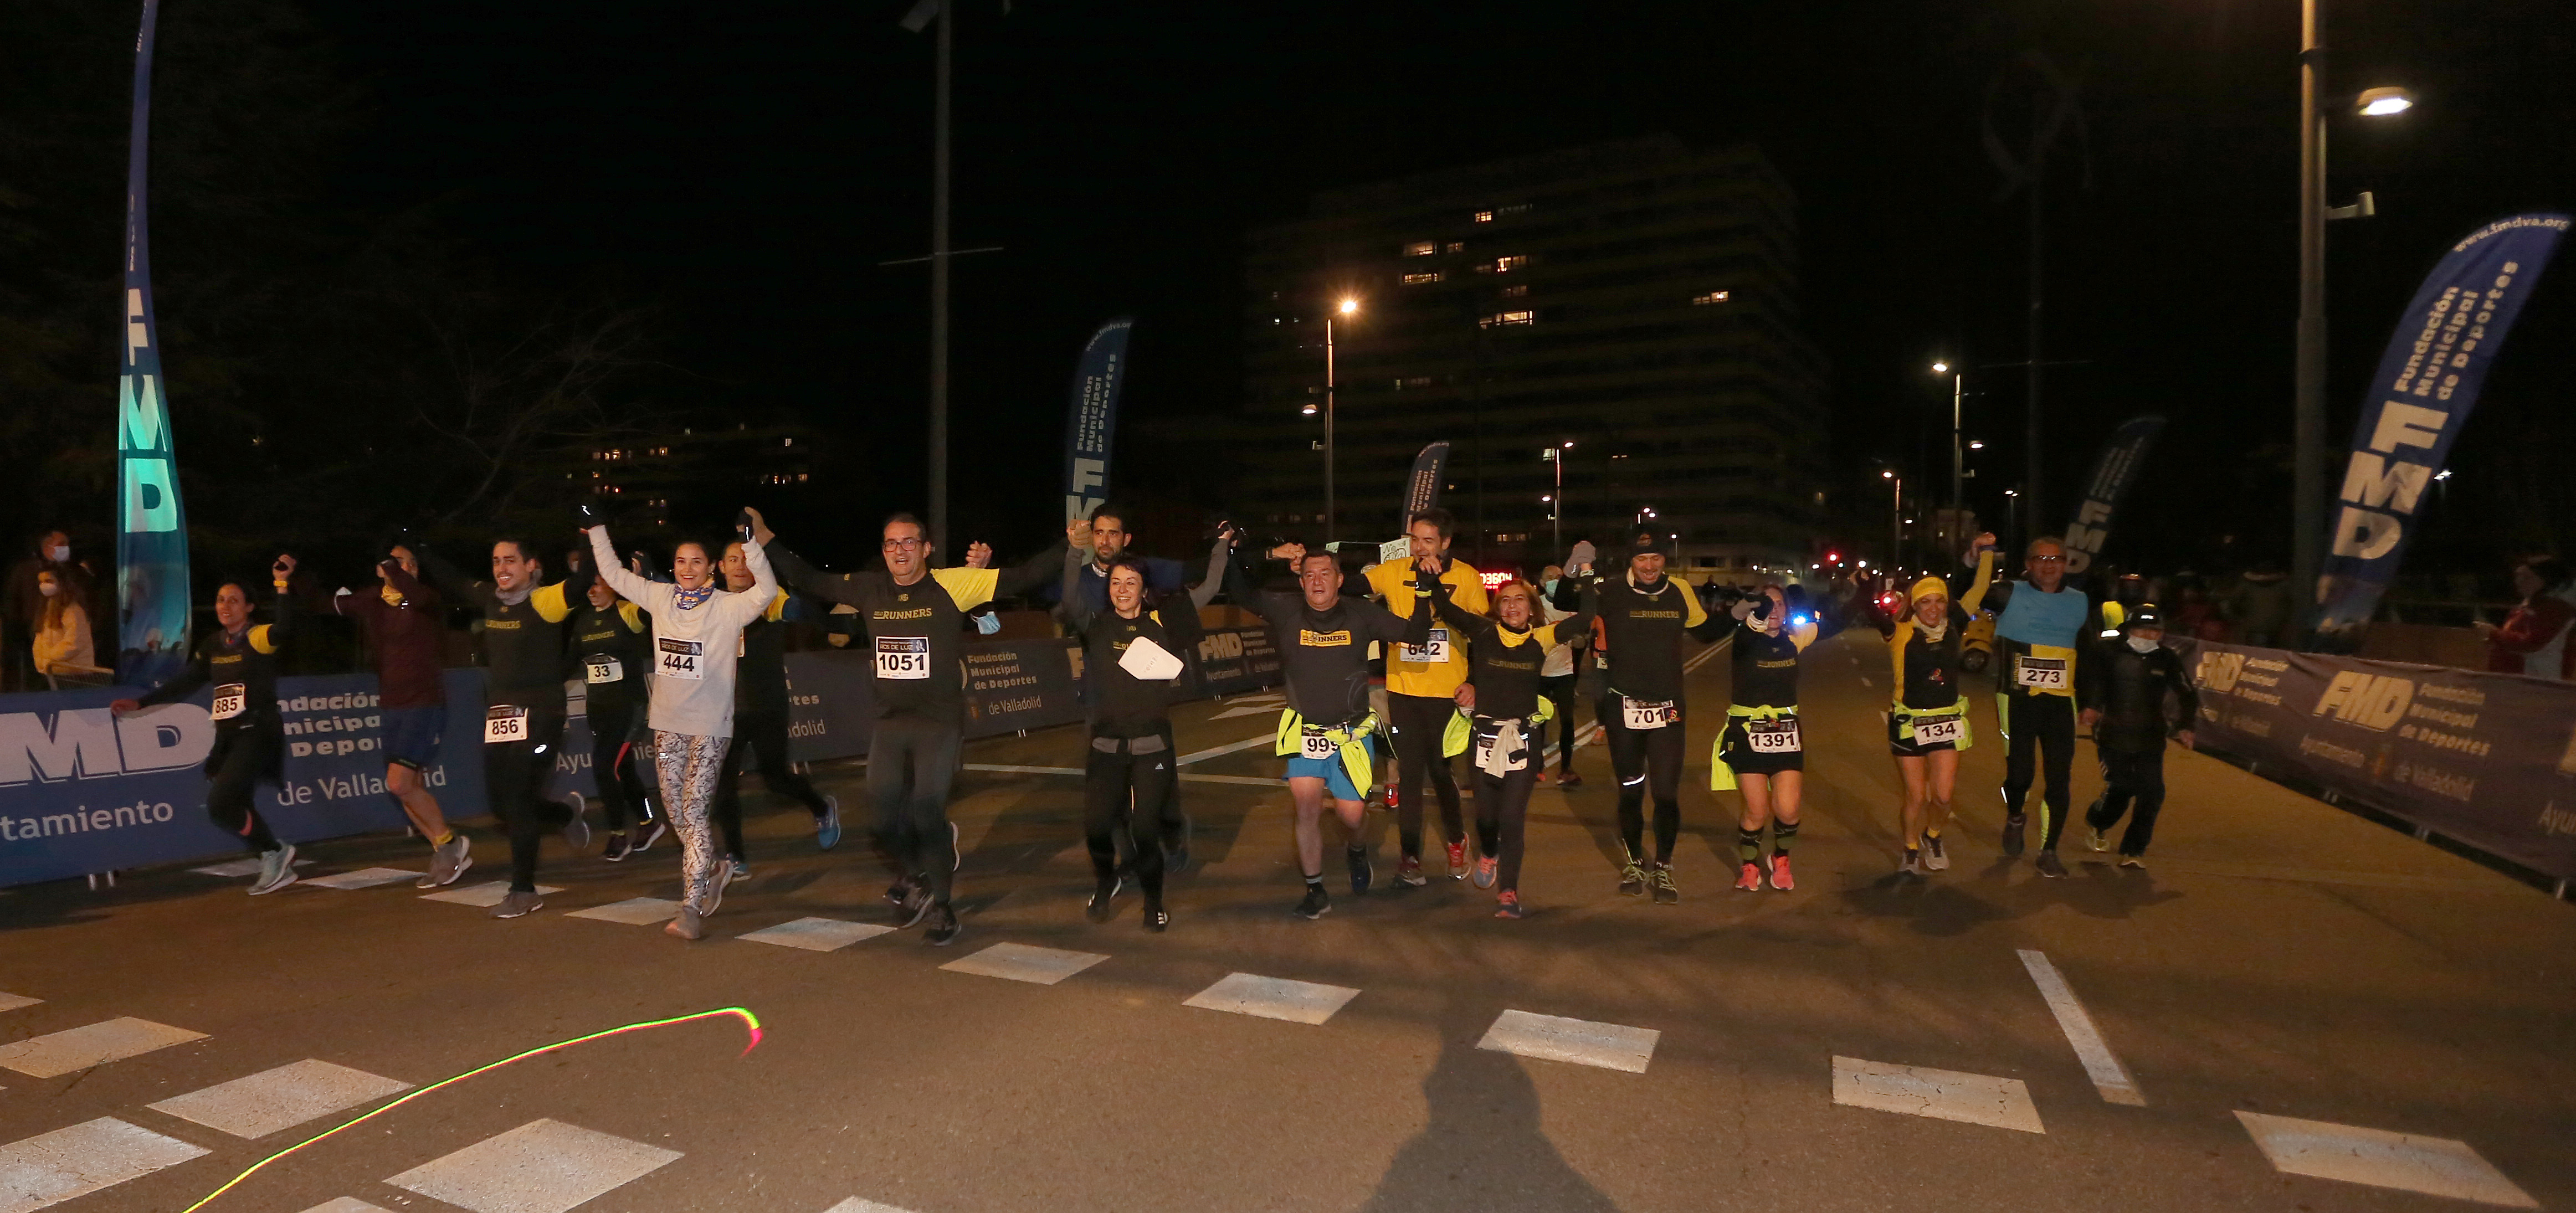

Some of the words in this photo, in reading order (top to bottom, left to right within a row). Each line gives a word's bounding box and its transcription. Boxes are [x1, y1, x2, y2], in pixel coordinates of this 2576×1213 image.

[2454, 217, 2568, 251] www.fmdva.org
[2437, 374, 2459, 400] de
[2451, 261, 2518, 368] Deportes
[2414, 290, 2478, 397] Municipal
[118, 288, 177, 533] FMD
[1086, 377, 1102, 451] Municipal
[2332, 400, 2449, 560] FMD
[883, 608, 932, 620] RUNNERS
[1642, 610, 1680, 619] RUNNERS
[1198, 633, 1243, 662] FMD
[1408, 643, 1440, 655] 642
[664, 654, 694, 672] 444
[879, 654, 924, 671] 1051
[967, 652, 1017, 664] Fundación
[594, 665, 610, 677] 33
[970, 664, 1020, 677] Municipal
[2026, 669, 2060, 683] 273
[974, 681, 987, 691] de
[989, 676, 1037, 688] Deportes
[215, 698, 237, 713] 885
[989, 702, 1000, 715] de
[1000, 695, 1042, 713] Valladolid
[2312, 670, 2414, 732] FMD
[1632, 709, 1665, 723] 701
[492, 719, 519, 735] 856
[1922, 723, 1956, 737] 134
[1751, 734, 1795, 747] 1391
[278, 781, 312, 806] de
